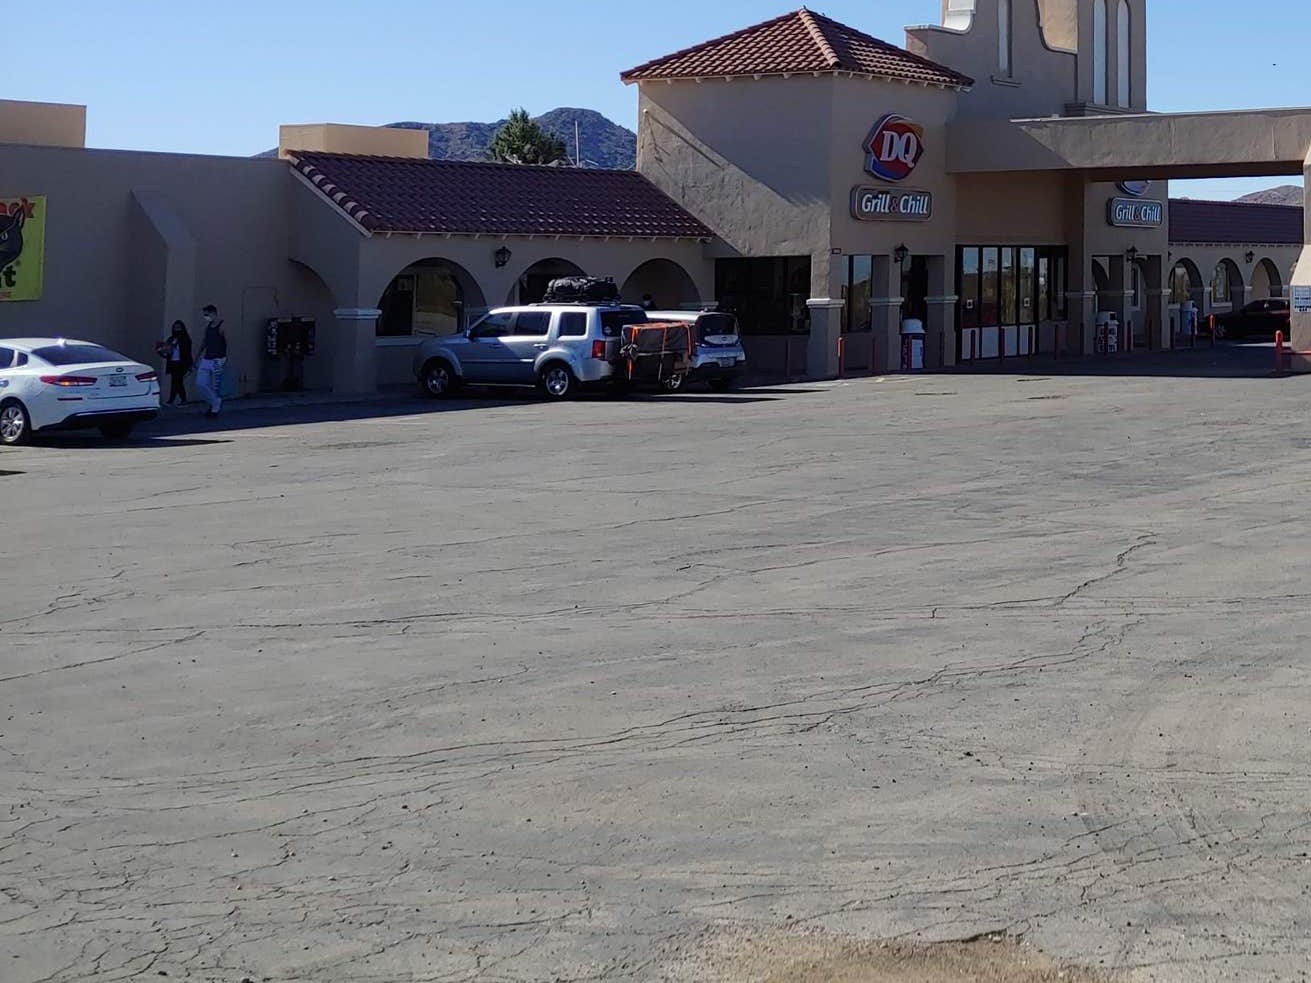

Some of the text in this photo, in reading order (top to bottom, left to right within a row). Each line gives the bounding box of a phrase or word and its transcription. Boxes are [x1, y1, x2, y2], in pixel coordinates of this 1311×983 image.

[880, 131, 918, 168] DQ
[862, 194, 928, 214] Grill & Chill
[1116, 204, 1134, 220] Grill
[1141, 206, 1160, 222] Chill
